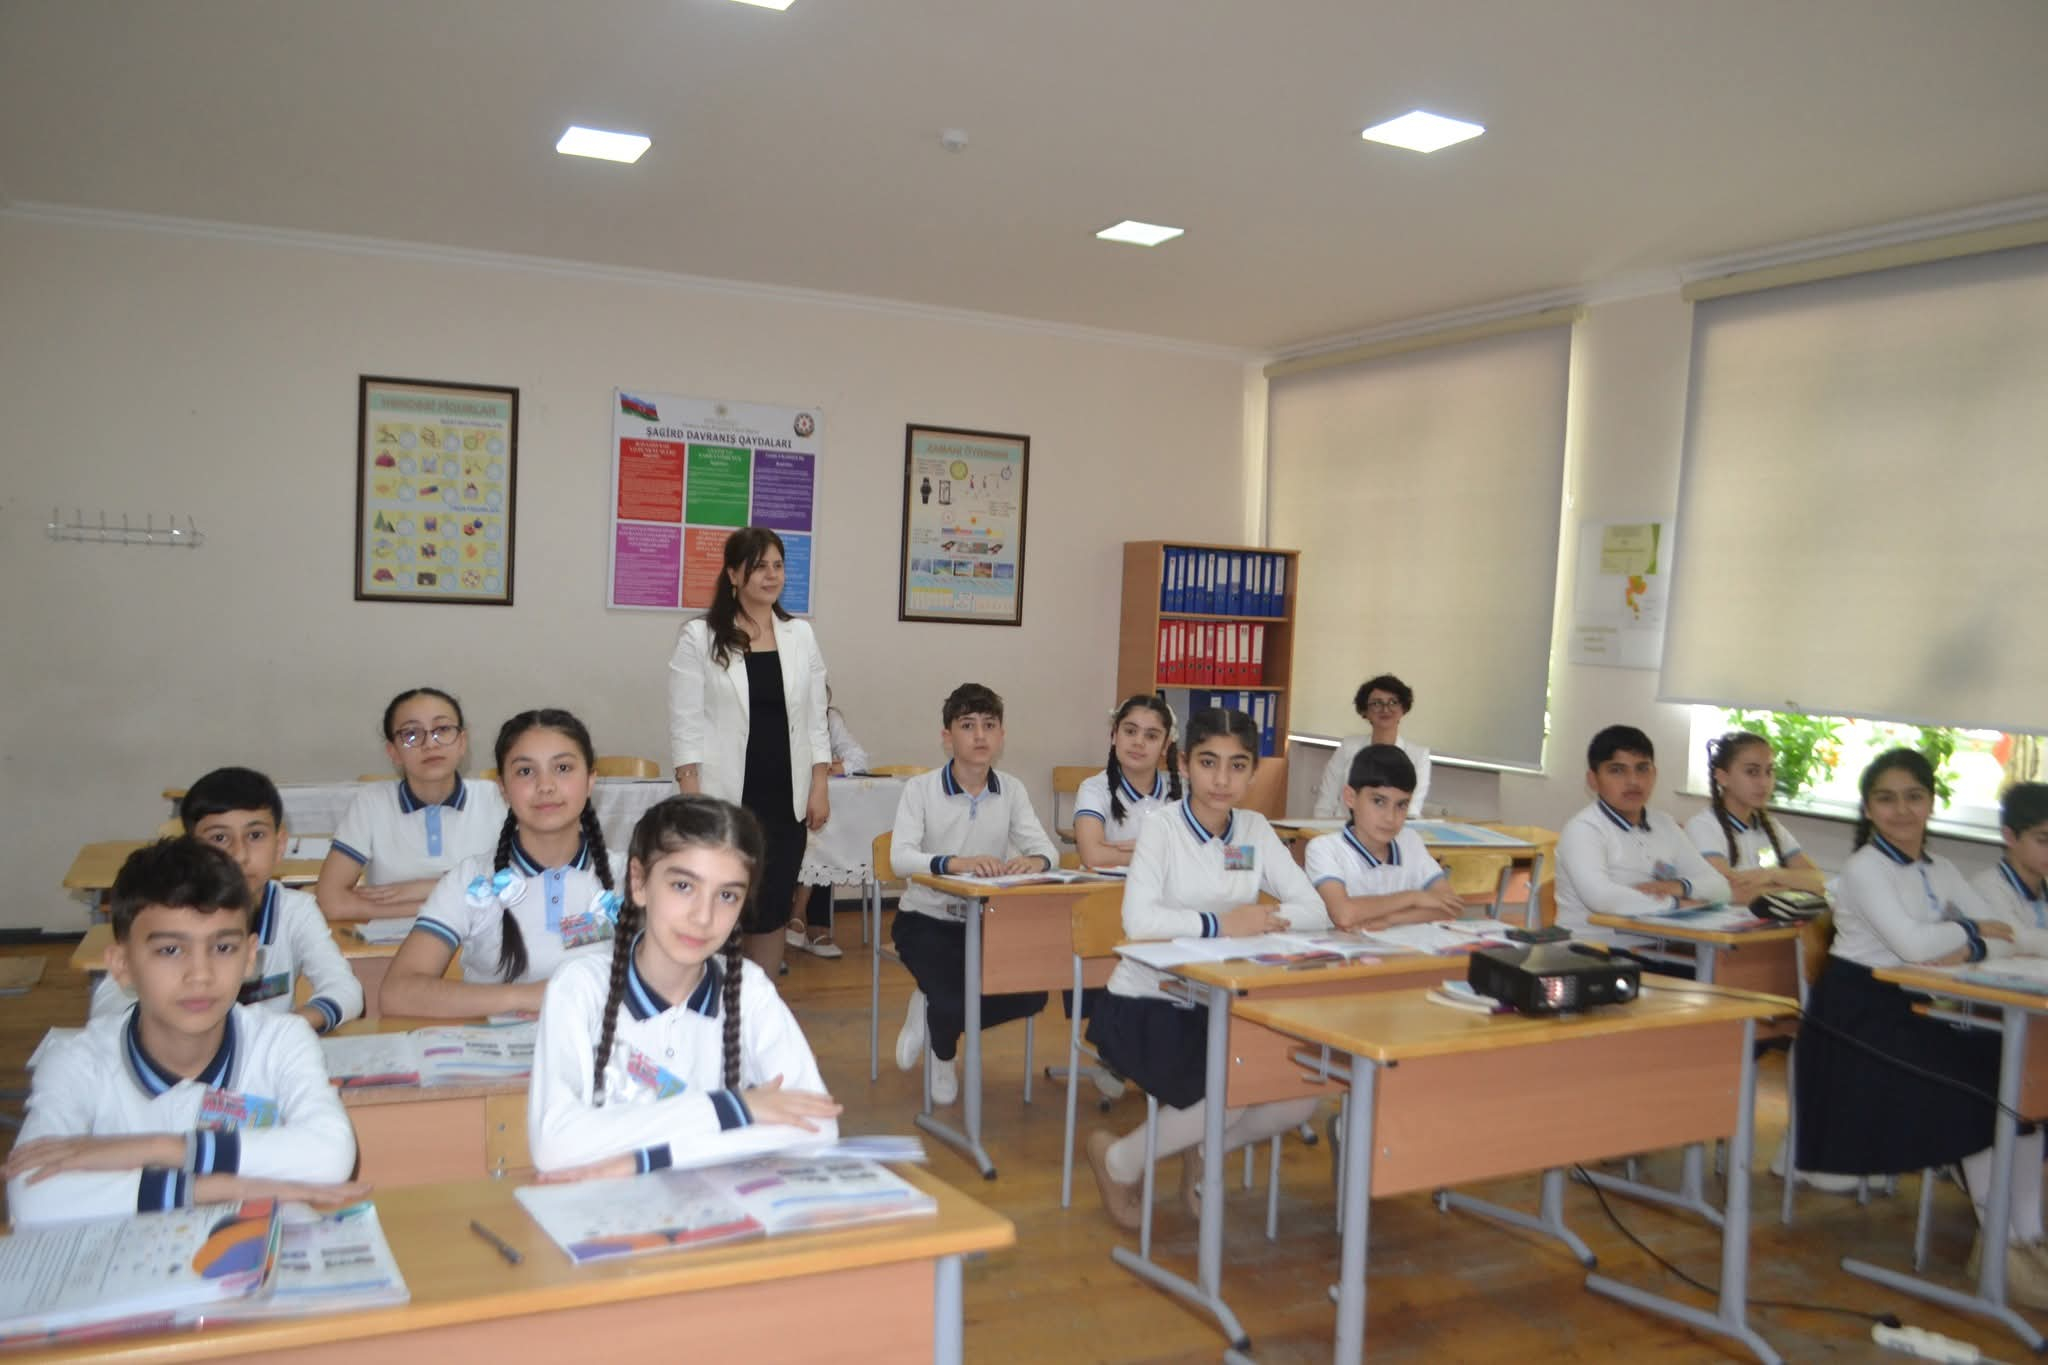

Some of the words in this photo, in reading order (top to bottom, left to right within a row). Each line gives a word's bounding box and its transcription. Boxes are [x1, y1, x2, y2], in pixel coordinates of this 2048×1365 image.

[646, 426, 684, 439] ŞAGİRD
[686, 430, 736, 444] DAVRANIŞ
[738, 436, 792, 449] QAYDALARI
